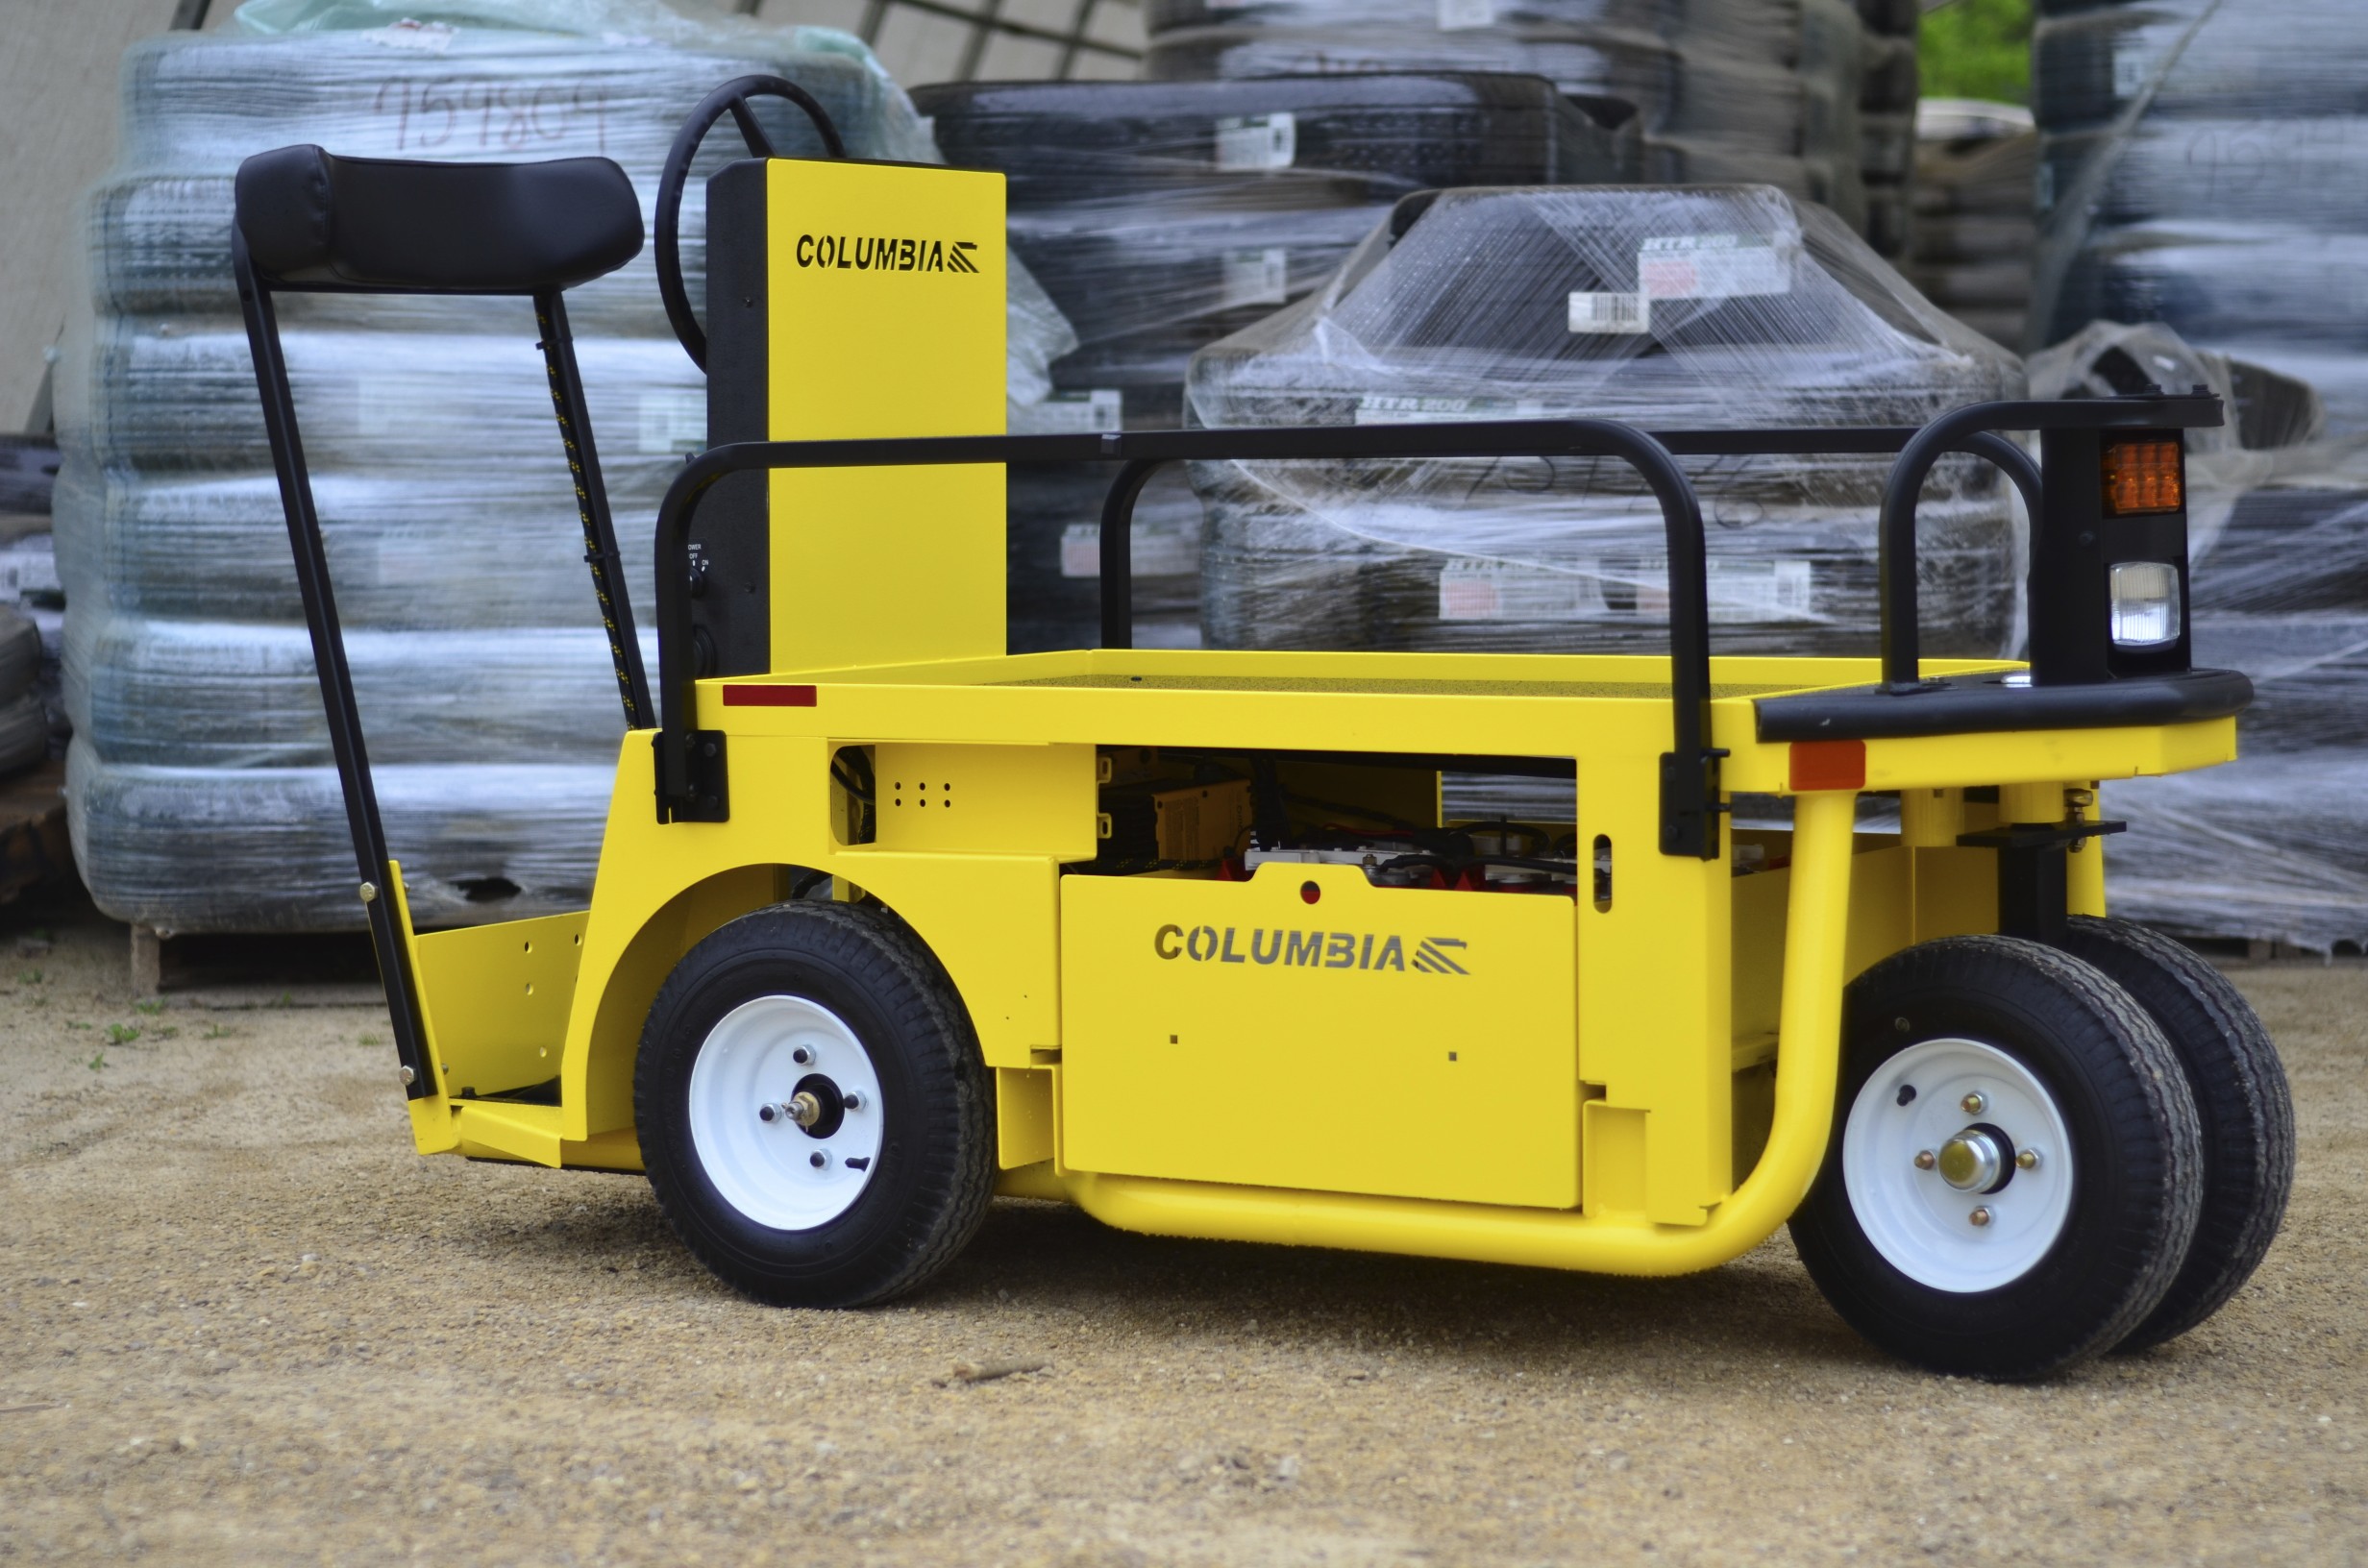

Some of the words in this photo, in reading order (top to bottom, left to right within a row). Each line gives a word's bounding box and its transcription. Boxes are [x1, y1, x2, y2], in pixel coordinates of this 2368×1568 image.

[796, 234, 944, 272] COLUMBIA
[1360, 395, 1418, 410] HTR
[1420, 398, 1468, 412] 200
[1153, 923, 1406, 972] COLUMBIA
